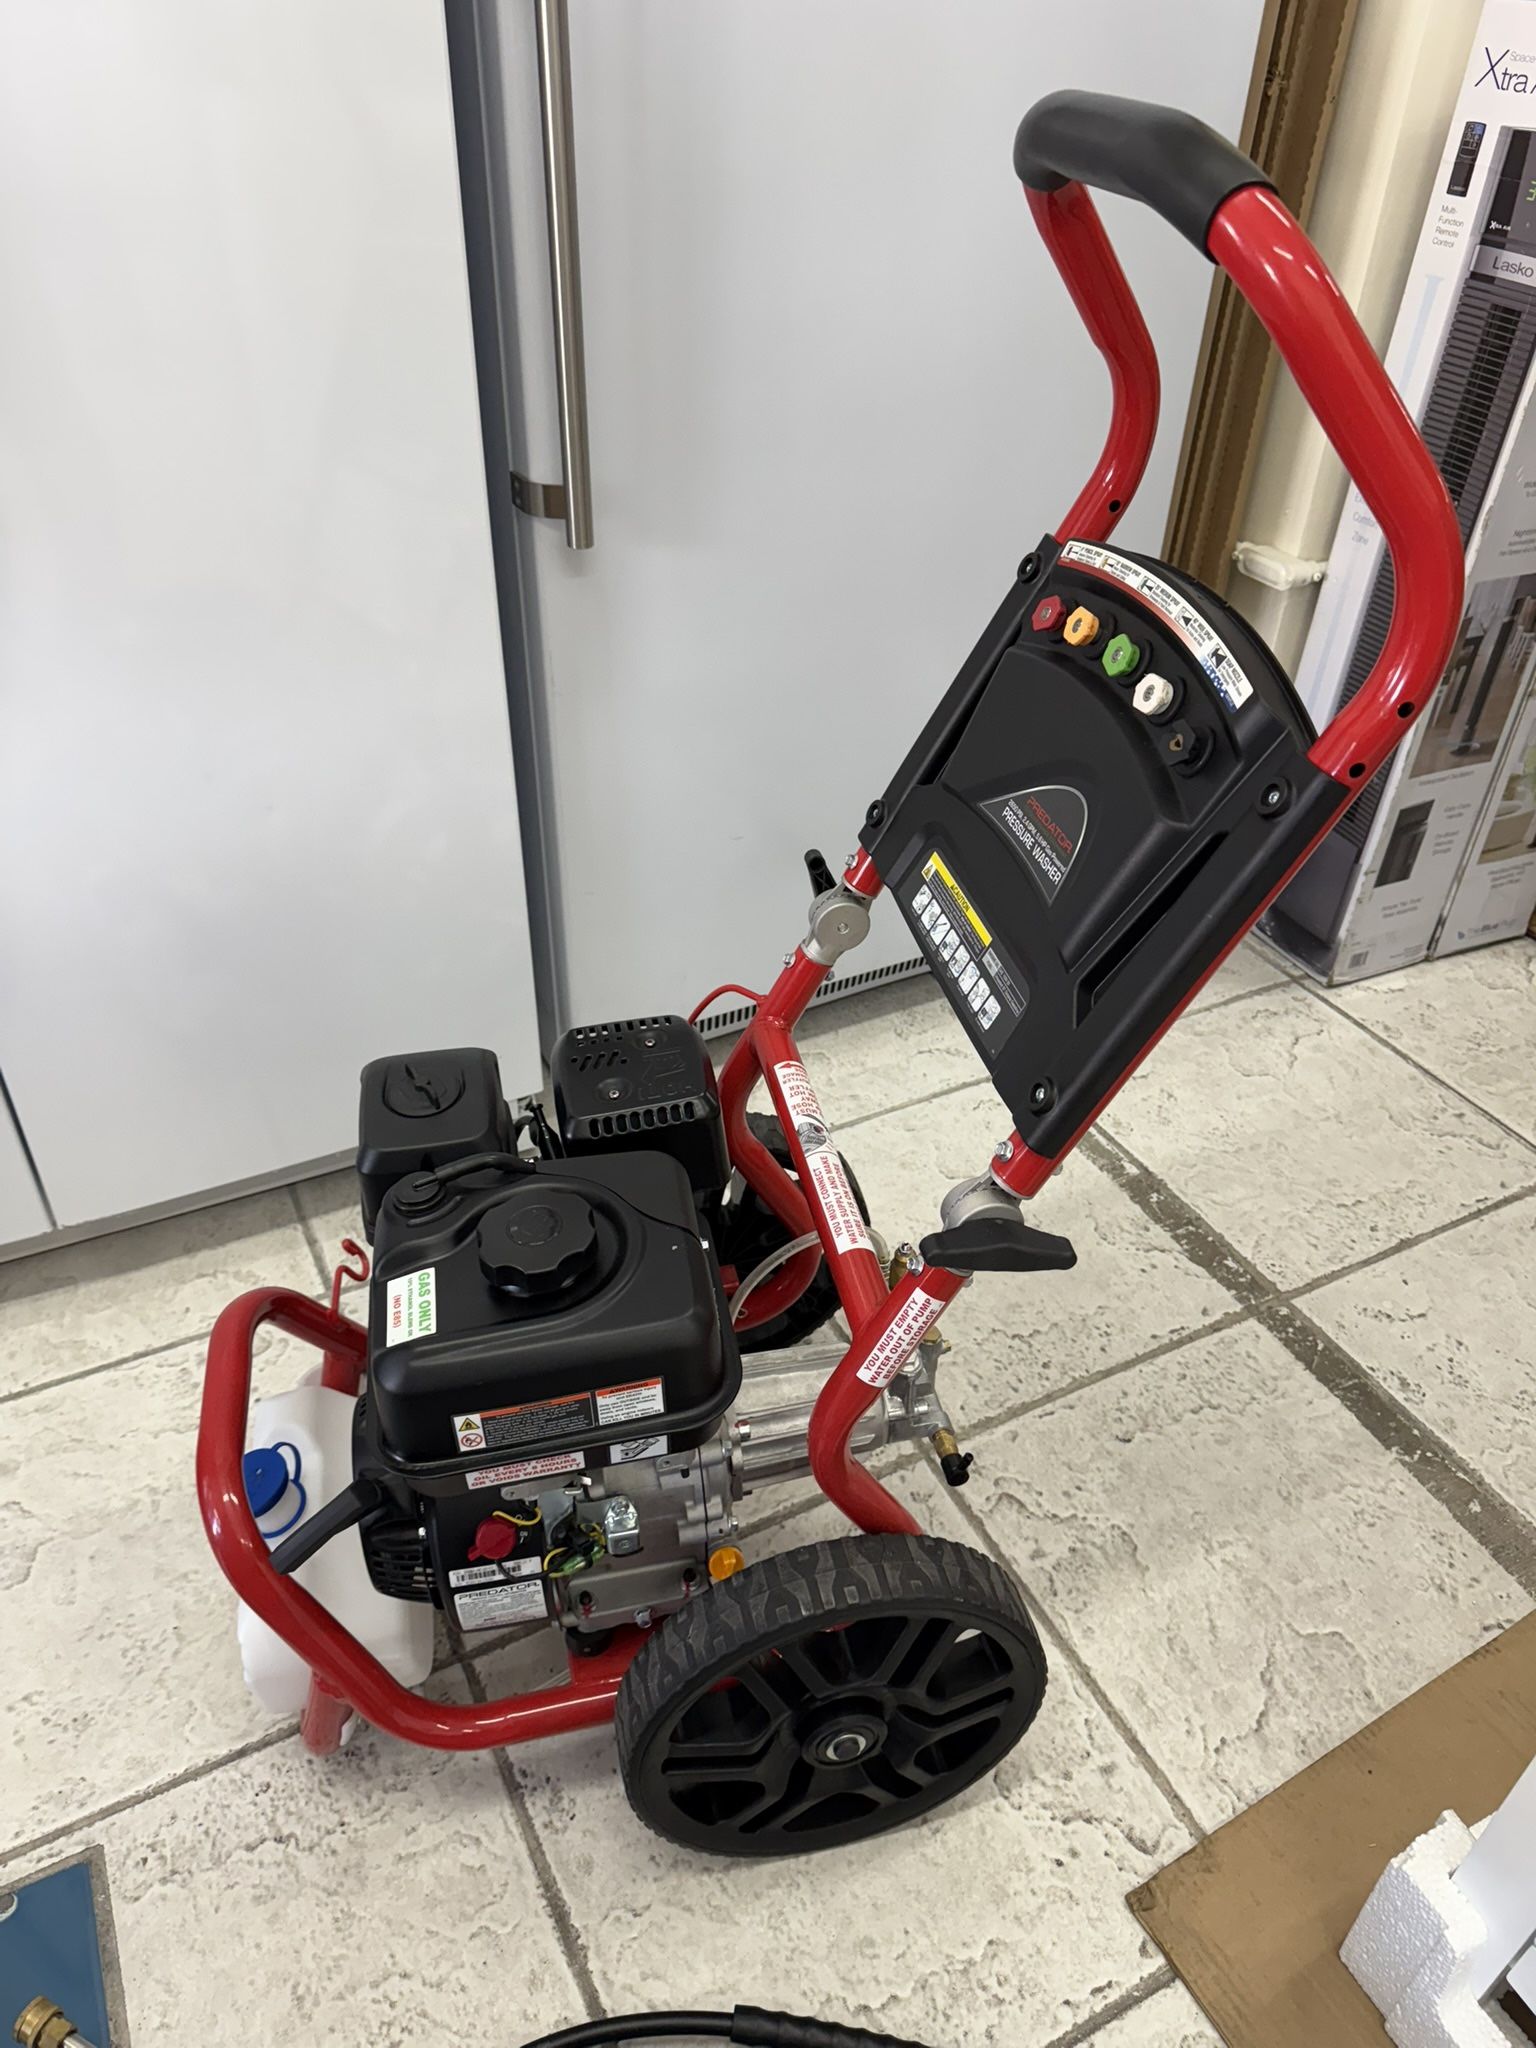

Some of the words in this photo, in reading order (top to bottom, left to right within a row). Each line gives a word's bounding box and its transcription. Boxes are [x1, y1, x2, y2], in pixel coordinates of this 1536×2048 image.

[1475, 47, 1527, 93] Xtra
[1435, 226, 1459, 237] Remote
[1438, 215, 1464, 227] Function
[1432, 237, 1455, 248] Control
[1492, 256, 1534, 278] Lasko
[1026, 796, 1075, 855] PREDATOR
[1002, 807, 1036, 850] PRESSURE
[1031, 844, 1062, 885] WASHER
[952, 887, 971, 912] CAUTION
[820, 1155, 833, 1176] MAKE
[833, 1162, 847, 1189] BEFORE
[813, 1166, 831, 1200] CONNECT
[827, 1175, 838, 1191] AND
[833, 1191, 849, 1219] SUPPLY
[843, 1189, 851, 1201] ON
[847, 1201, 855, 1210] IS
[825, 1200, 838, 1221] MUST
[850, 1209, 858, 1218] IT
[832, 1221, 844, 1238] YOU
[843, 1218, 858, 1245] WATER
[854, 1218, 866, 1239] SURE
[419, 1272, 430, 1297] GAS
[393, 1295, 402, 1309] (NO
[393, 1311, 401, 1328] E85)
[419, 1300, 431, 1331] ONLY
[864, 1353, 881, 1373] YOU
[877, 1328, 898, 1354] MUST
[895, 1298, 919, 1329] EMPTY
[869, 1354, 893, 1385] WATER
[889, 1336, 906, 1356] OUT
[903, 1323, 915, 1337] OF
[912, 1297, 933, 1323] PUMP
[882, 1347, 909, 1381] BEFORE
[906, 1308, 937, 1348] STORAGE
[489, 1474, 520, 1483] VOIDS
[523, 1463, 581, 1477] WARRANTY
[495, 1468, 528, 1477] EVERY
[541, 1458, 577, 1469] HOURS
[503, 1462, 532, 1471] MUST
[536, 1455, 571, 1465] CHECK
[459, 1582, 537, 1600] PREDATOR
